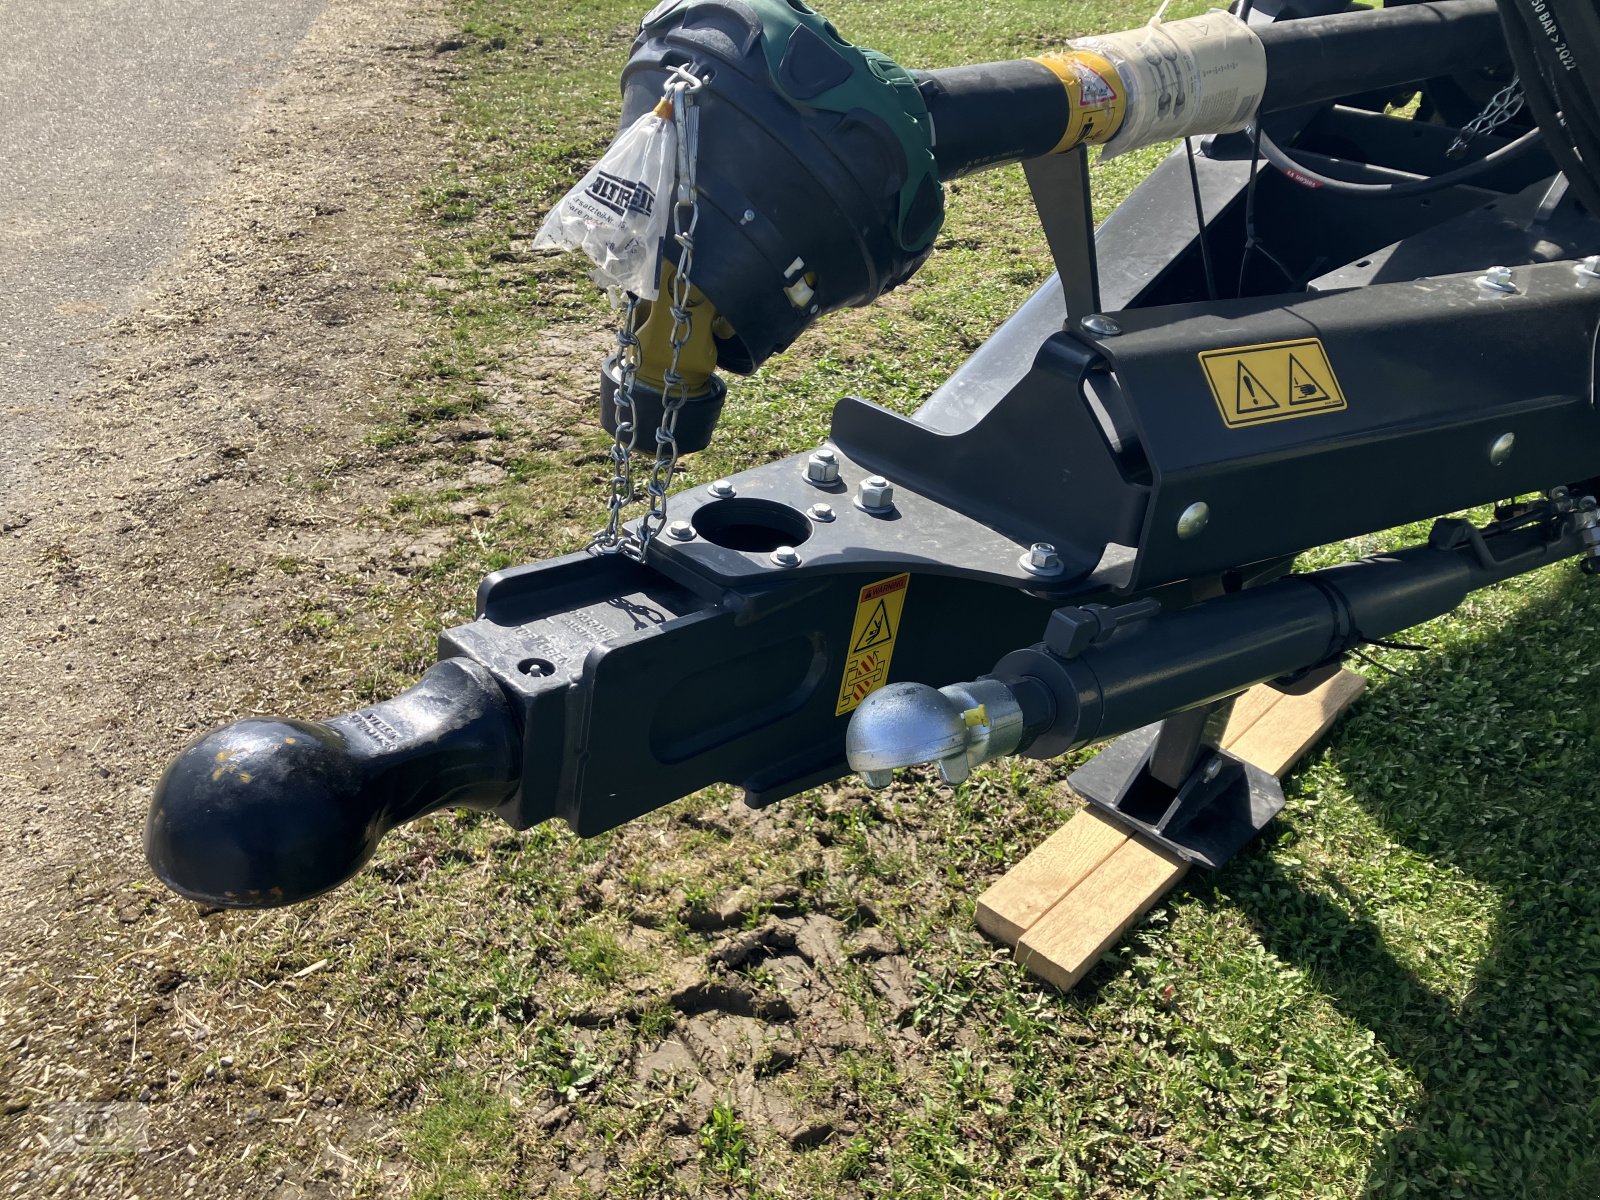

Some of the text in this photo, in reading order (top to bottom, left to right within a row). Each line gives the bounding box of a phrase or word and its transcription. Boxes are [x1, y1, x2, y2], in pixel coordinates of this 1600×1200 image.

[1530, 0, 1546, 13] 50
[1539, 11, 1557, 36] BAR
[1555, 43, 1577, 71] 2Q22
[872, 578, 905, 595] WARNING
